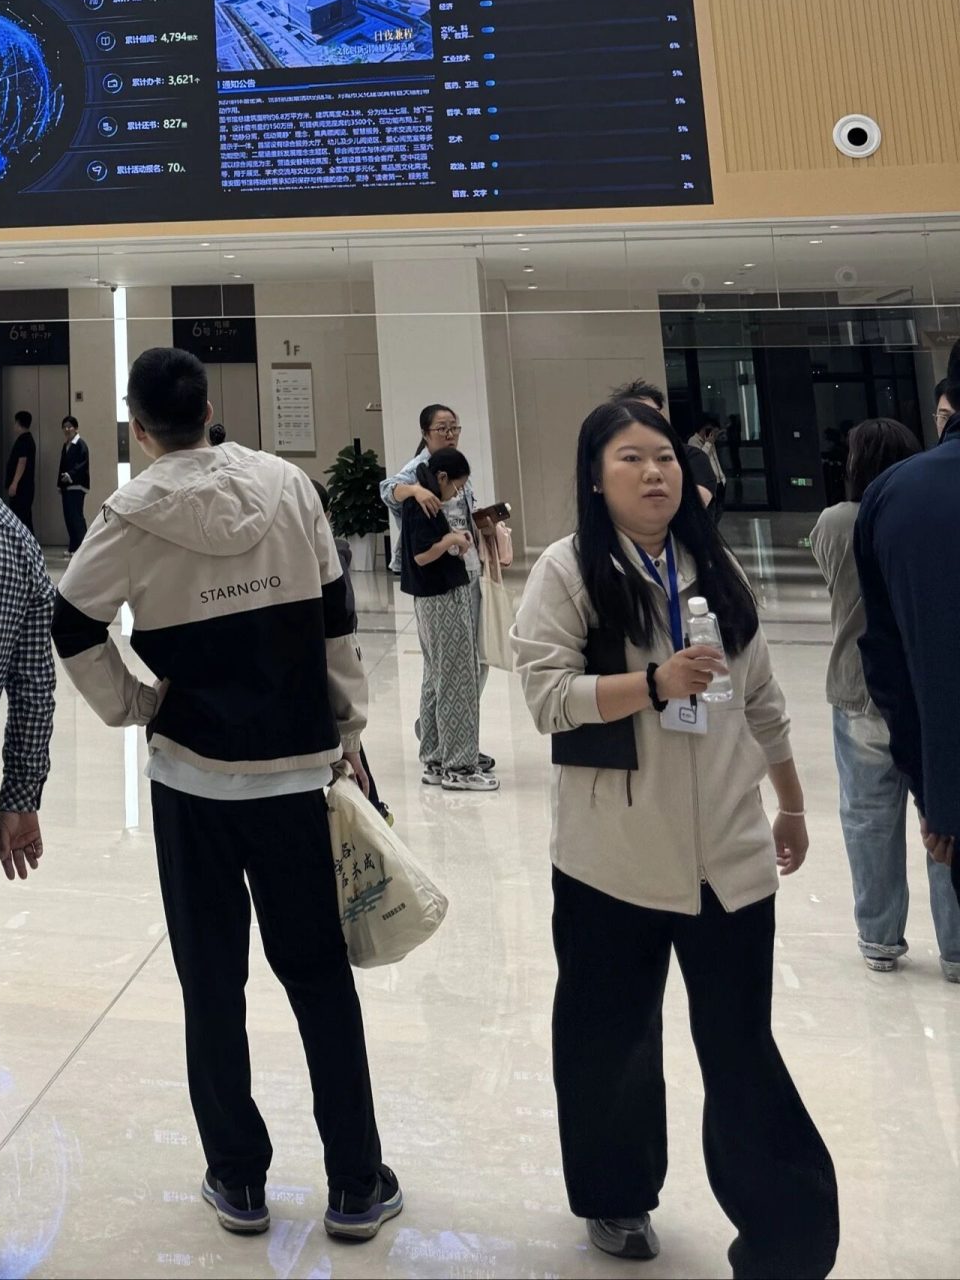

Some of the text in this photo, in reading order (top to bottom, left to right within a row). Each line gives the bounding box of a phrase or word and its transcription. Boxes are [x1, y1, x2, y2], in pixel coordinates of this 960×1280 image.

[222, 79, 256, 89] 通知公告
[283, 340, 300, 356] 1F
[200, 576, 281, 604] STARNOVO
